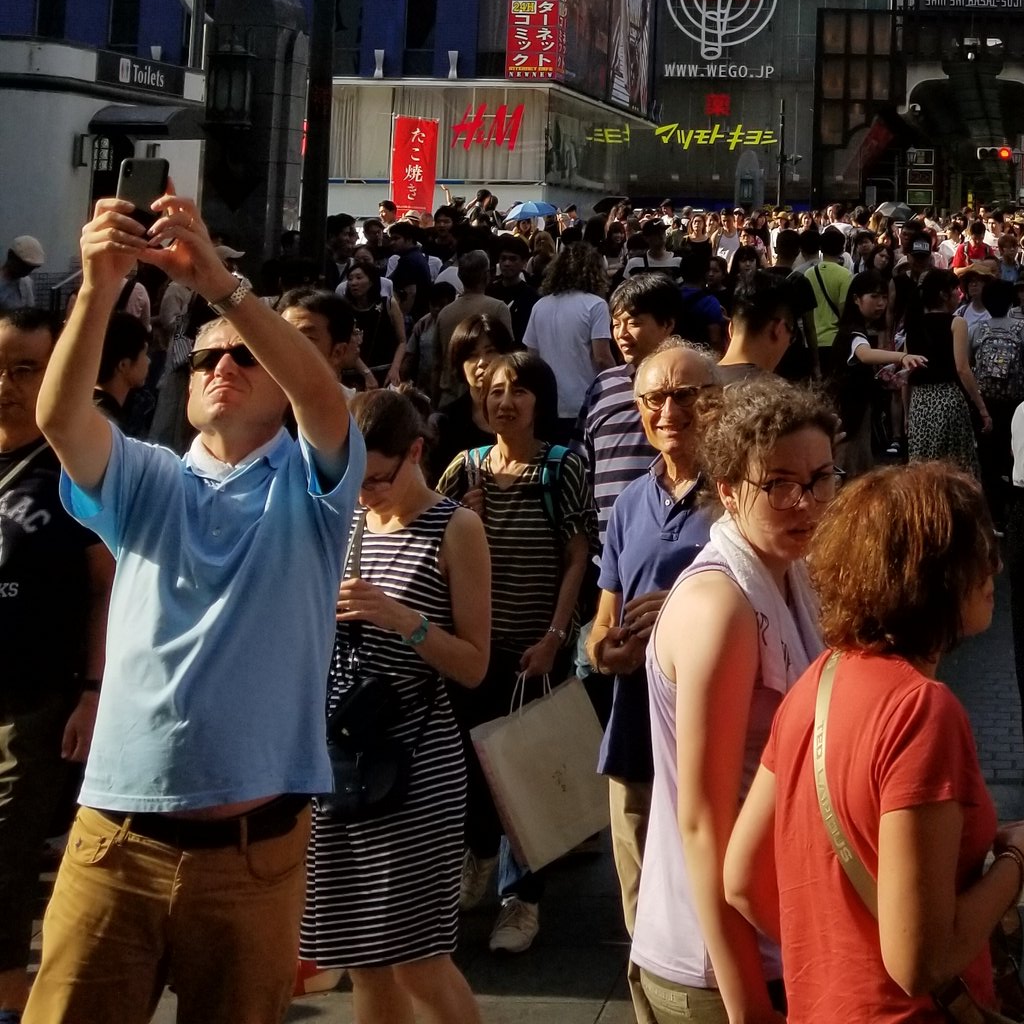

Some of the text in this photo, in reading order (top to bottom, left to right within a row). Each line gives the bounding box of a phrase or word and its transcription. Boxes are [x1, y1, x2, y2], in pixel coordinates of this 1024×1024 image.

[512, 1, 536, 12] 24H
[512, 15, 532, 67] コミック
[133, 64, 164, 87] Toilets
[664, 64, 775, 79] WWW.WEGO.JP
[452, 103, 525, 151] H&M
[655, 123, 778, 150] マツモトキヨシ
[403, 127, 426, 201] たこ焼き
[815, 720, 825, 760] TED
